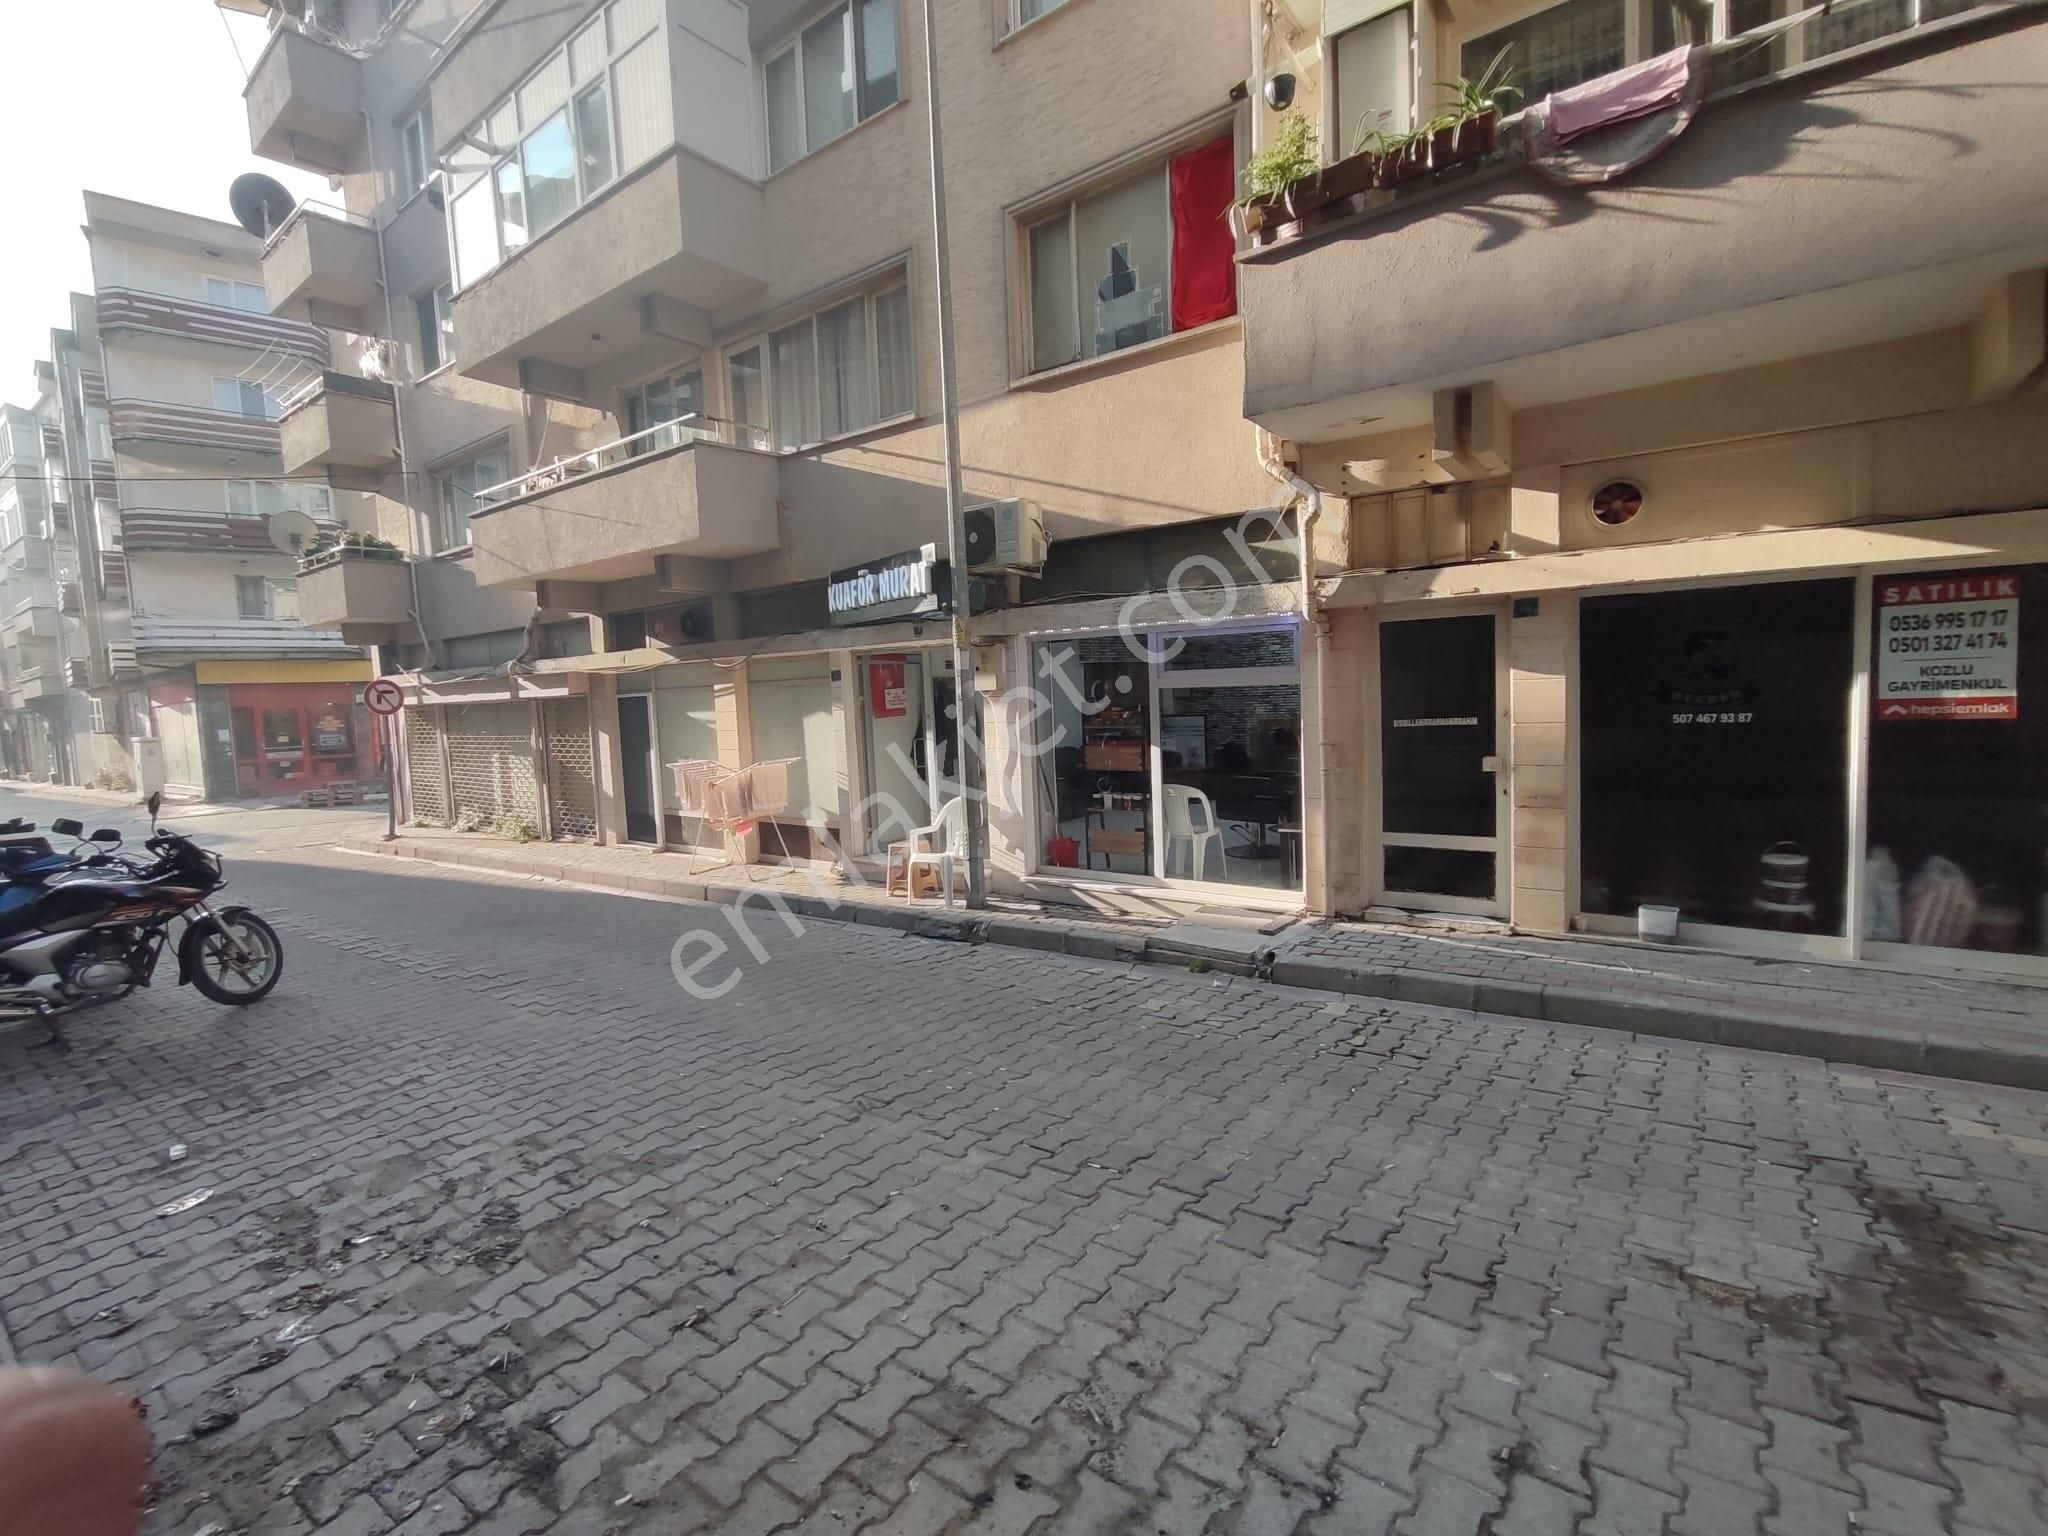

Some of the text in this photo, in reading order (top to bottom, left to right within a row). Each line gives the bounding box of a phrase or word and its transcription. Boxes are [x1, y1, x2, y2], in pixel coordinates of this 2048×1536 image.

[828, 560, 932, 612] KUAFÖR MURAT
[1885, 578, 2014, 603] SATILIK
[1889, 609, 2009, 631] 0536 995 17 17
[1889, 632, 2008, 653] 0501 327 41 74
[1919, 665, 1974, 676] KOZLU
[1887, 677, 2008, 692] GAYRİMENKUL
[1911, 703, 2010, 715] hepsiemlak
[1673, 713, 1752, 724] 507 467 93 87
